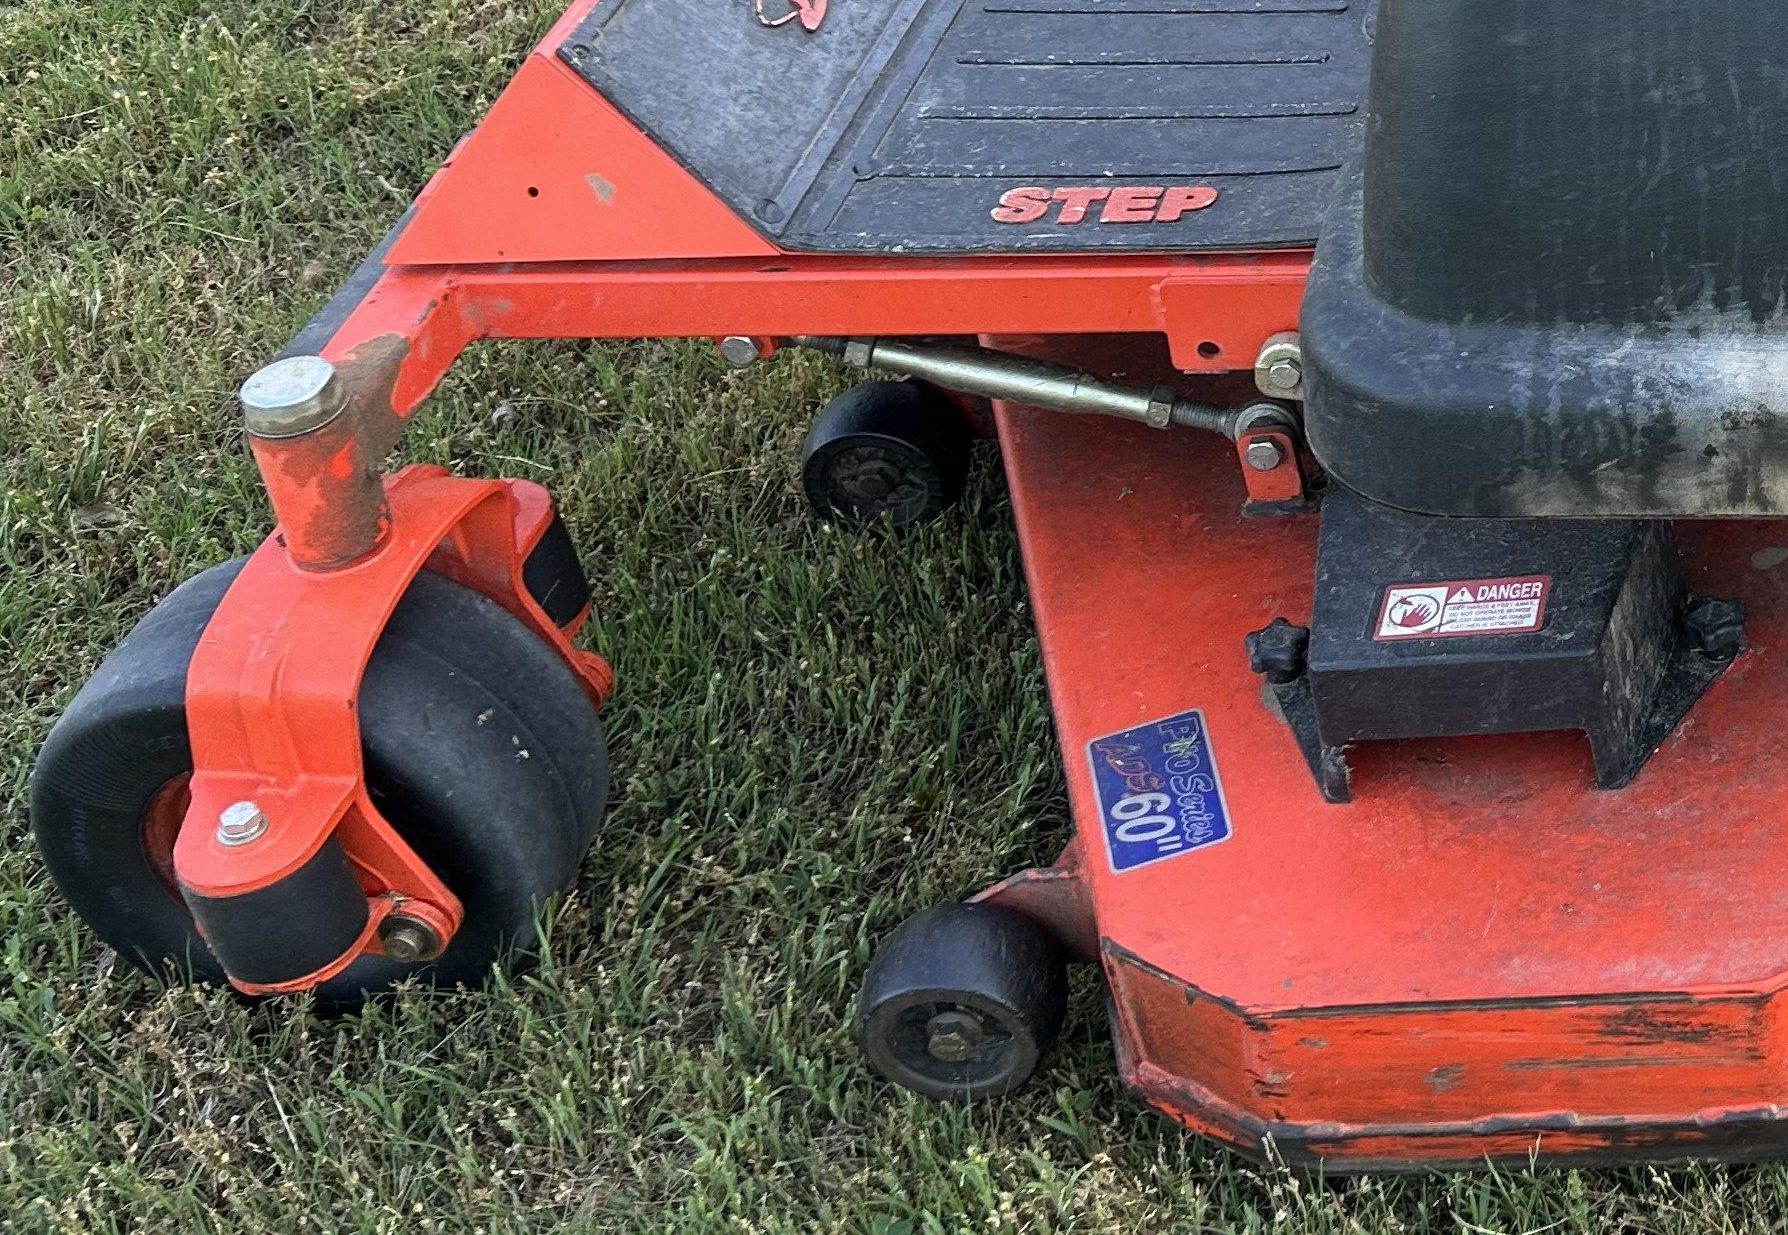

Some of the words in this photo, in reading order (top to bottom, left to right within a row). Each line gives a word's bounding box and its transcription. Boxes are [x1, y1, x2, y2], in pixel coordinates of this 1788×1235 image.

[990, 185, 1219, 225] STEP
[1476, 581, 1544, 602] DANGER
[1169, 772, 1216, 844] Series
